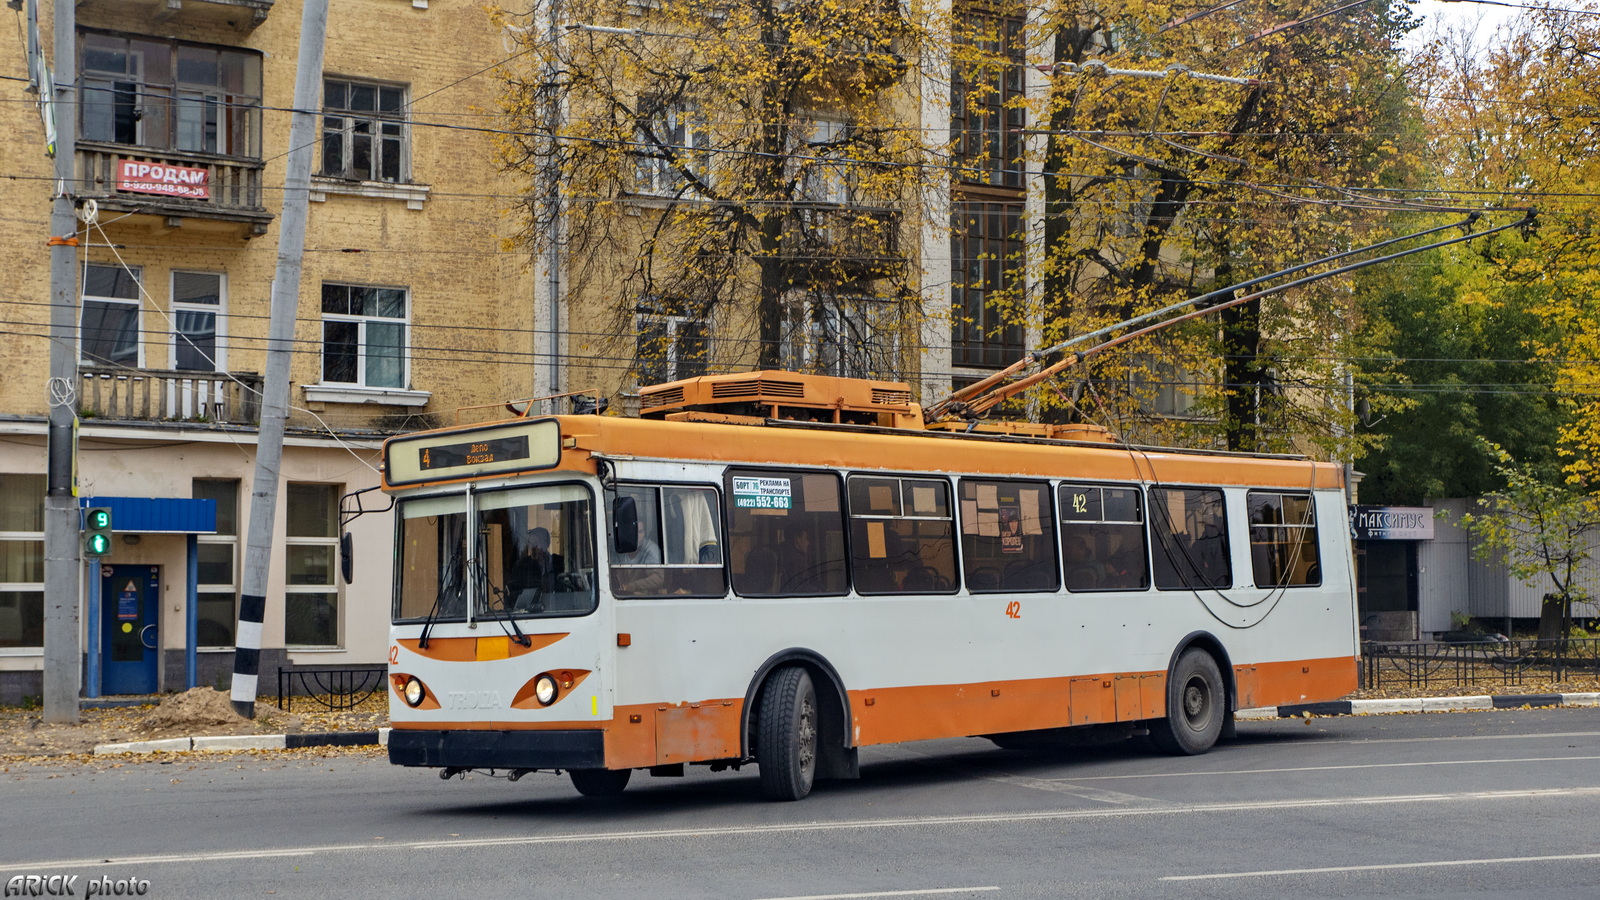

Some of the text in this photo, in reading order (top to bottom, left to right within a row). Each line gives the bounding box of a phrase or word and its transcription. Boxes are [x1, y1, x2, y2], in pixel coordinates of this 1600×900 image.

[124, 163, 205, 184] ПРОДАМ
[471, 444, 488, 453] Депо
[423, 449, 430, 468] 4
[466, 454, 494, 464] Вокзал
[736, 481, 749, 490] БОРТ
[737, 496, 789, 508] (4922) 552-663
[1072, 494, 1087, 513] 42
[97, 512, 108, 527] 9
[1359, 513, 1424, 528] МАКСИМУС
[1006, 601, 1020, 619] 42
[389, 645, 399, 665] 42
[448, 690, 502, 710] TROLZA
